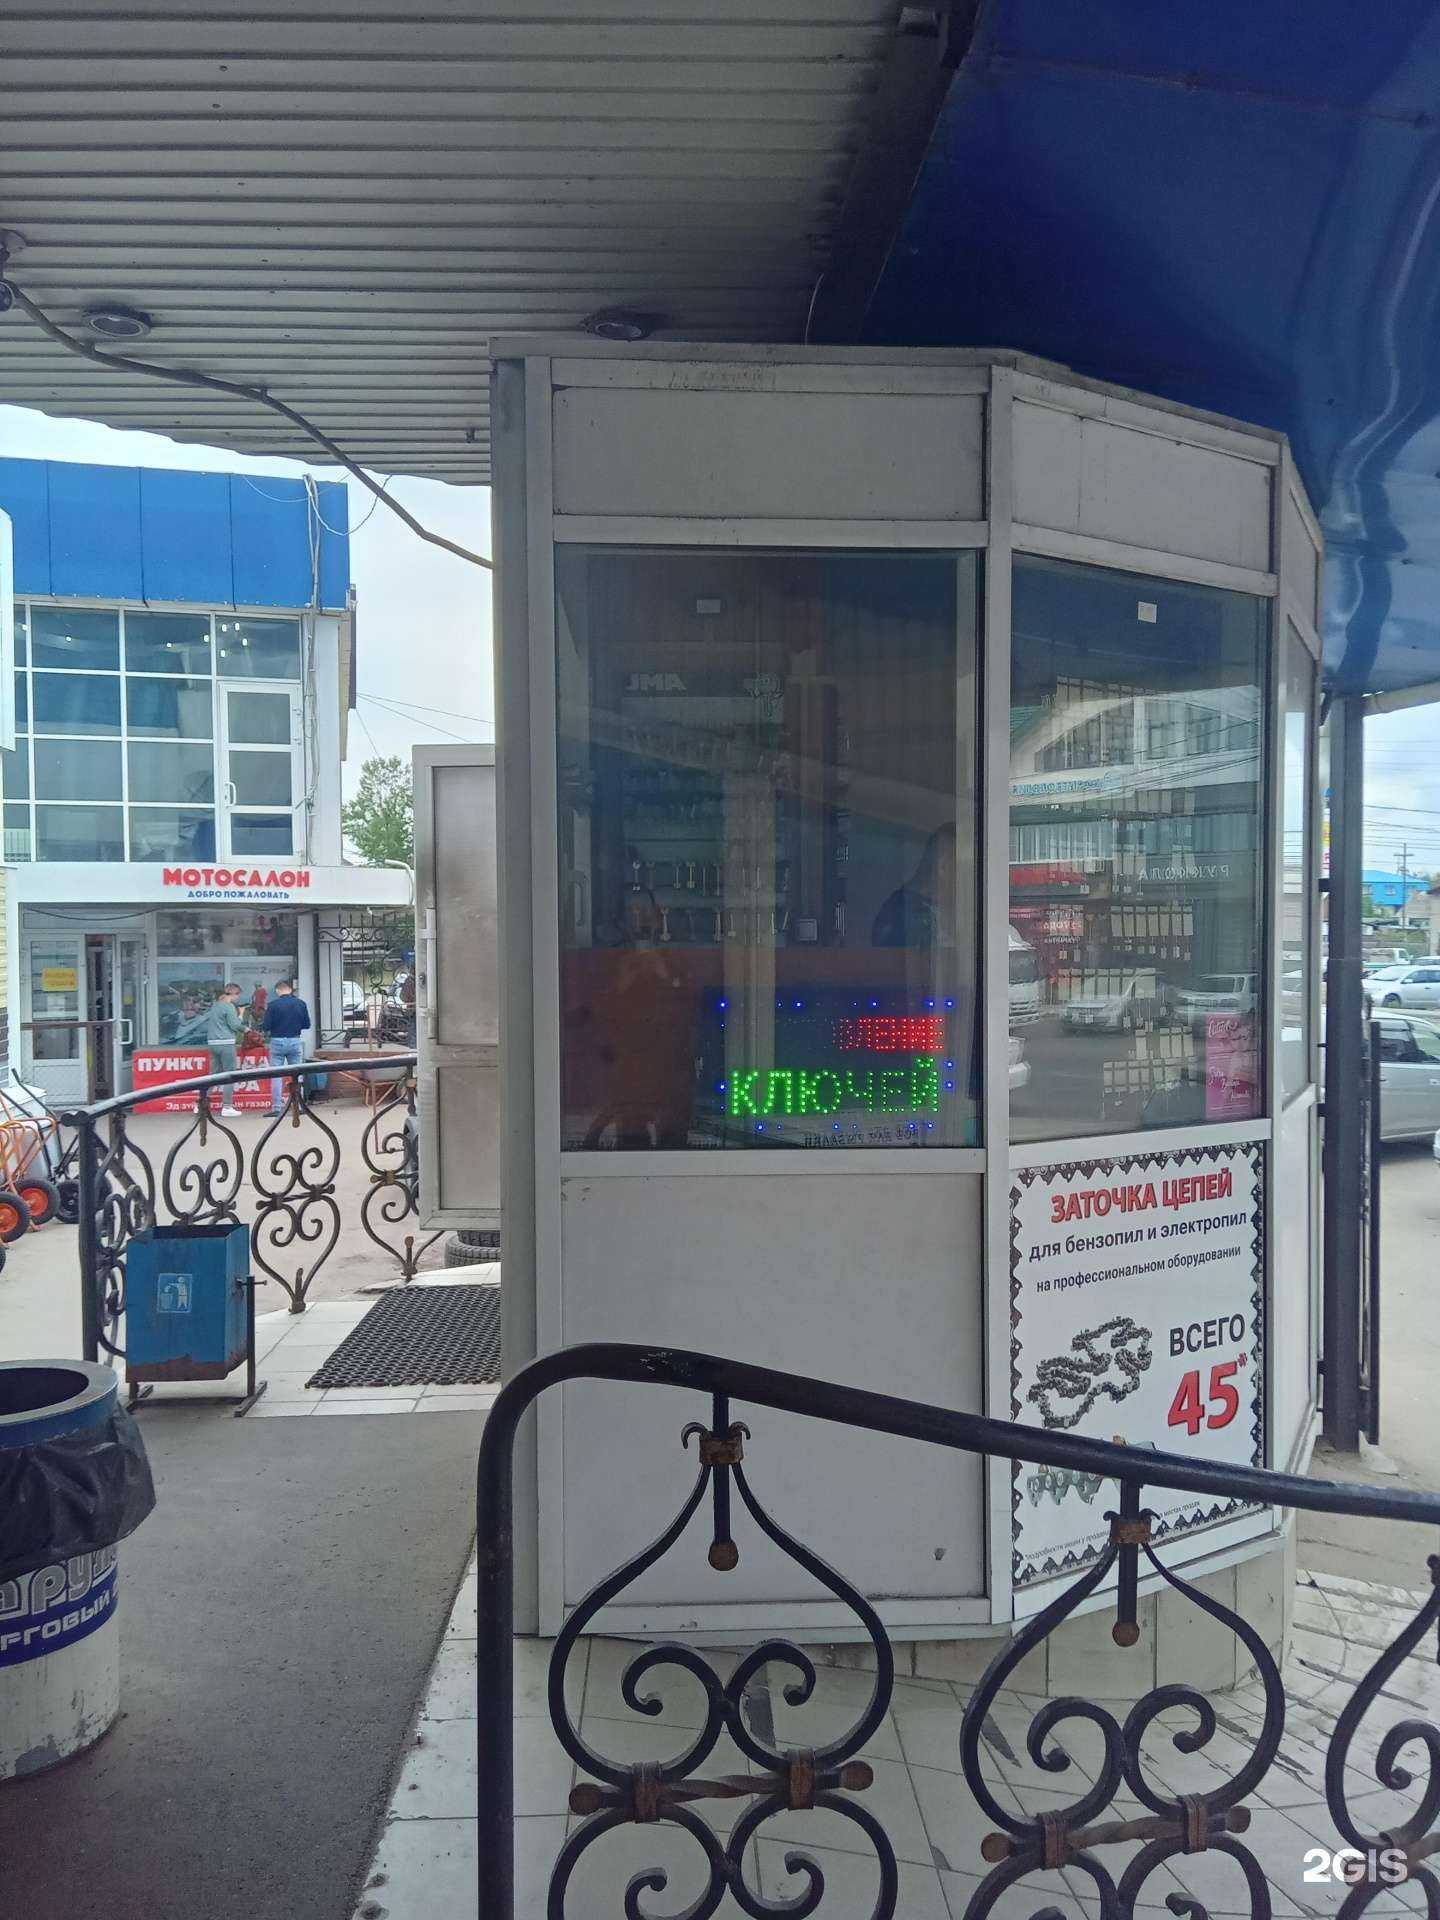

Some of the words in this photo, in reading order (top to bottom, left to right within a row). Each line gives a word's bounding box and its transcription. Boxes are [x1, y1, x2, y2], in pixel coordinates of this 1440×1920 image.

[162, 868, 310, 888] МОТОСАЛОН
[187, 890, 222, 899] ДОБРО
[223, 890, 290, 899] ПОЖАЛОВАТЬ
[138, 1056, 206, 1072] ПУНКТ
[731, 1056, 939, 1115] КЛЮЧЕЙ
[1050, 1182, 1157, 1224] ЗАТОЧКА
[1162, 1167, 1233, 1211] ЦЕПЕЙ
[1028, 1242, 1062, 1263] для
[1065, 1229, 1144, 1254] бензопил
[1147, 1226, 1157, 1240] и
[1160, 1212, 1248, 1238] электропил
[1036, 1278, 1051, 1293] на
[1053, 1260, 1166, 1294] профессиональном
[1167, 1245, 1242, 1272] оборудовании
[1169, 1313, 1246, 1357] ВСЕГО
